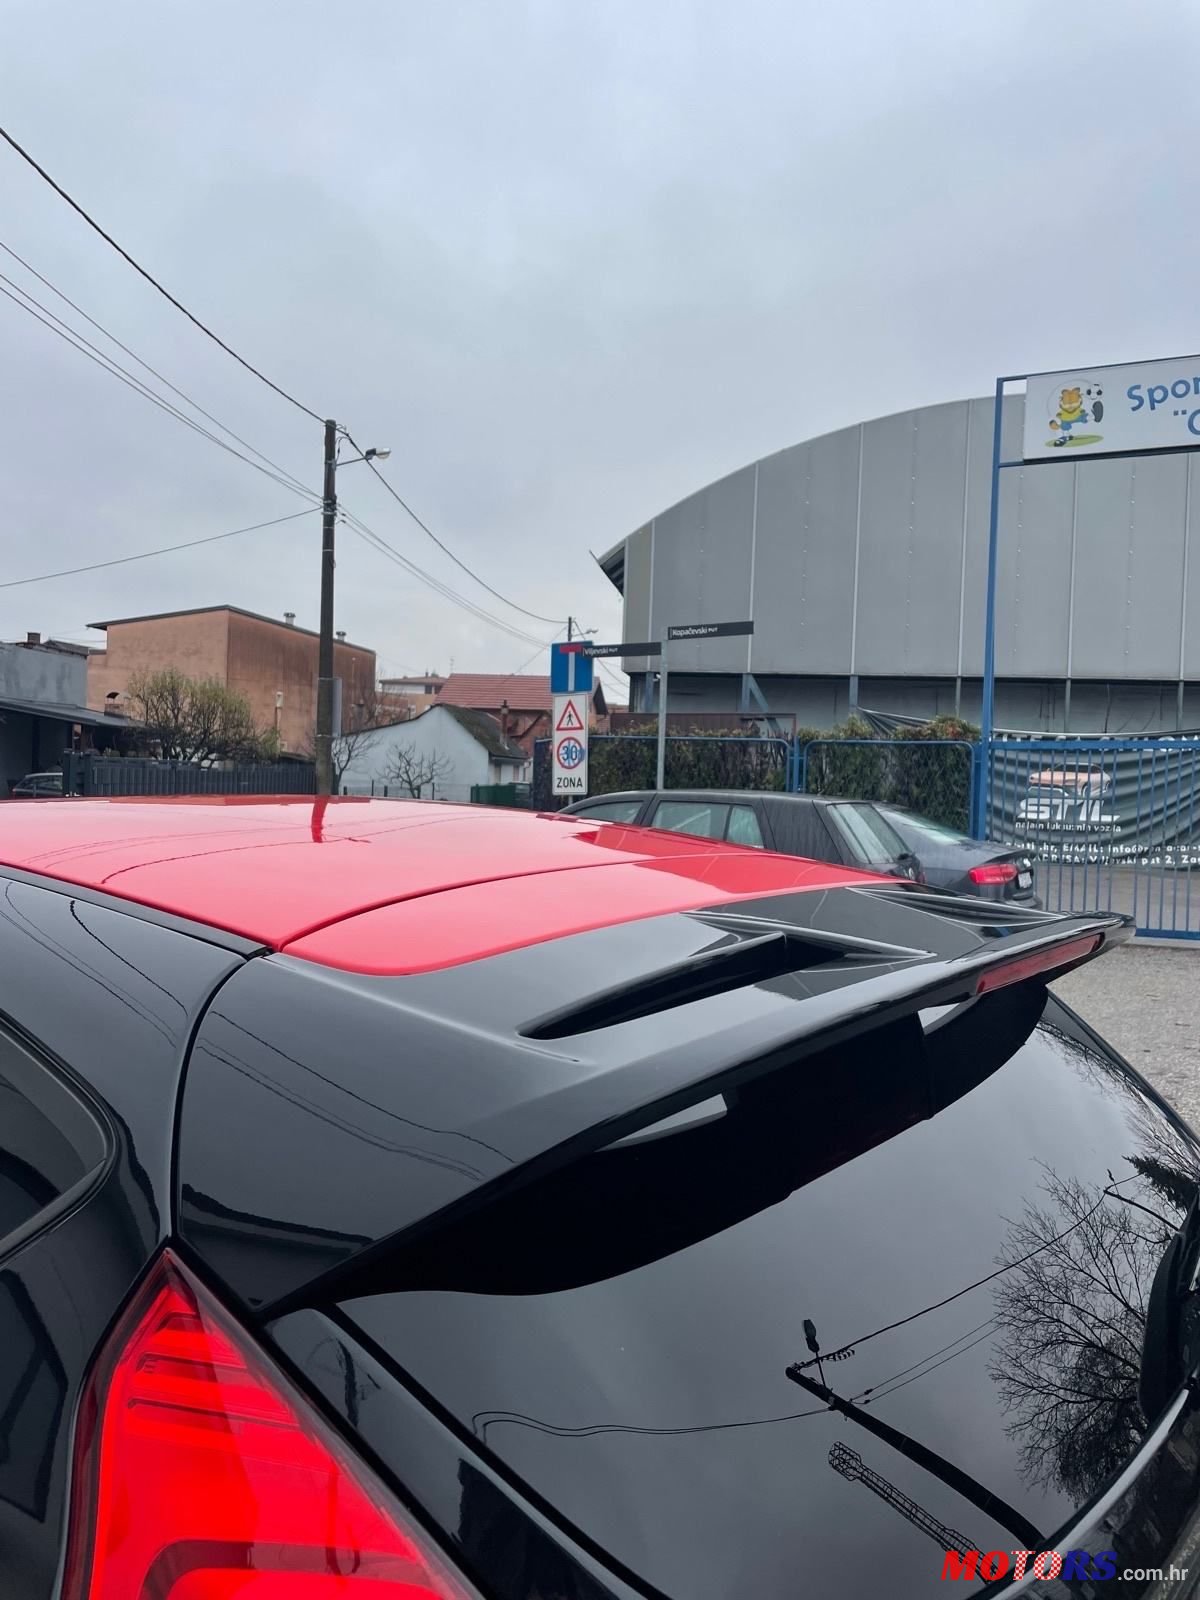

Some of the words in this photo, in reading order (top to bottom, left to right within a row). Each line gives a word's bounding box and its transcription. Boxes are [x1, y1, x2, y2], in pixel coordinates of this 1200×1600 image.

[672, 627, 707, 637] Kopačevski
[562, 745, 578, 761] 30
[556, 777, 583, 788] ZONA
[1017, 798, 1121, 822] STIL
[1094, 824, 1122, 833] vozla
[1090, 855, 1136, 865] Vljvski
[1181, 855, 1200, 865] Za
